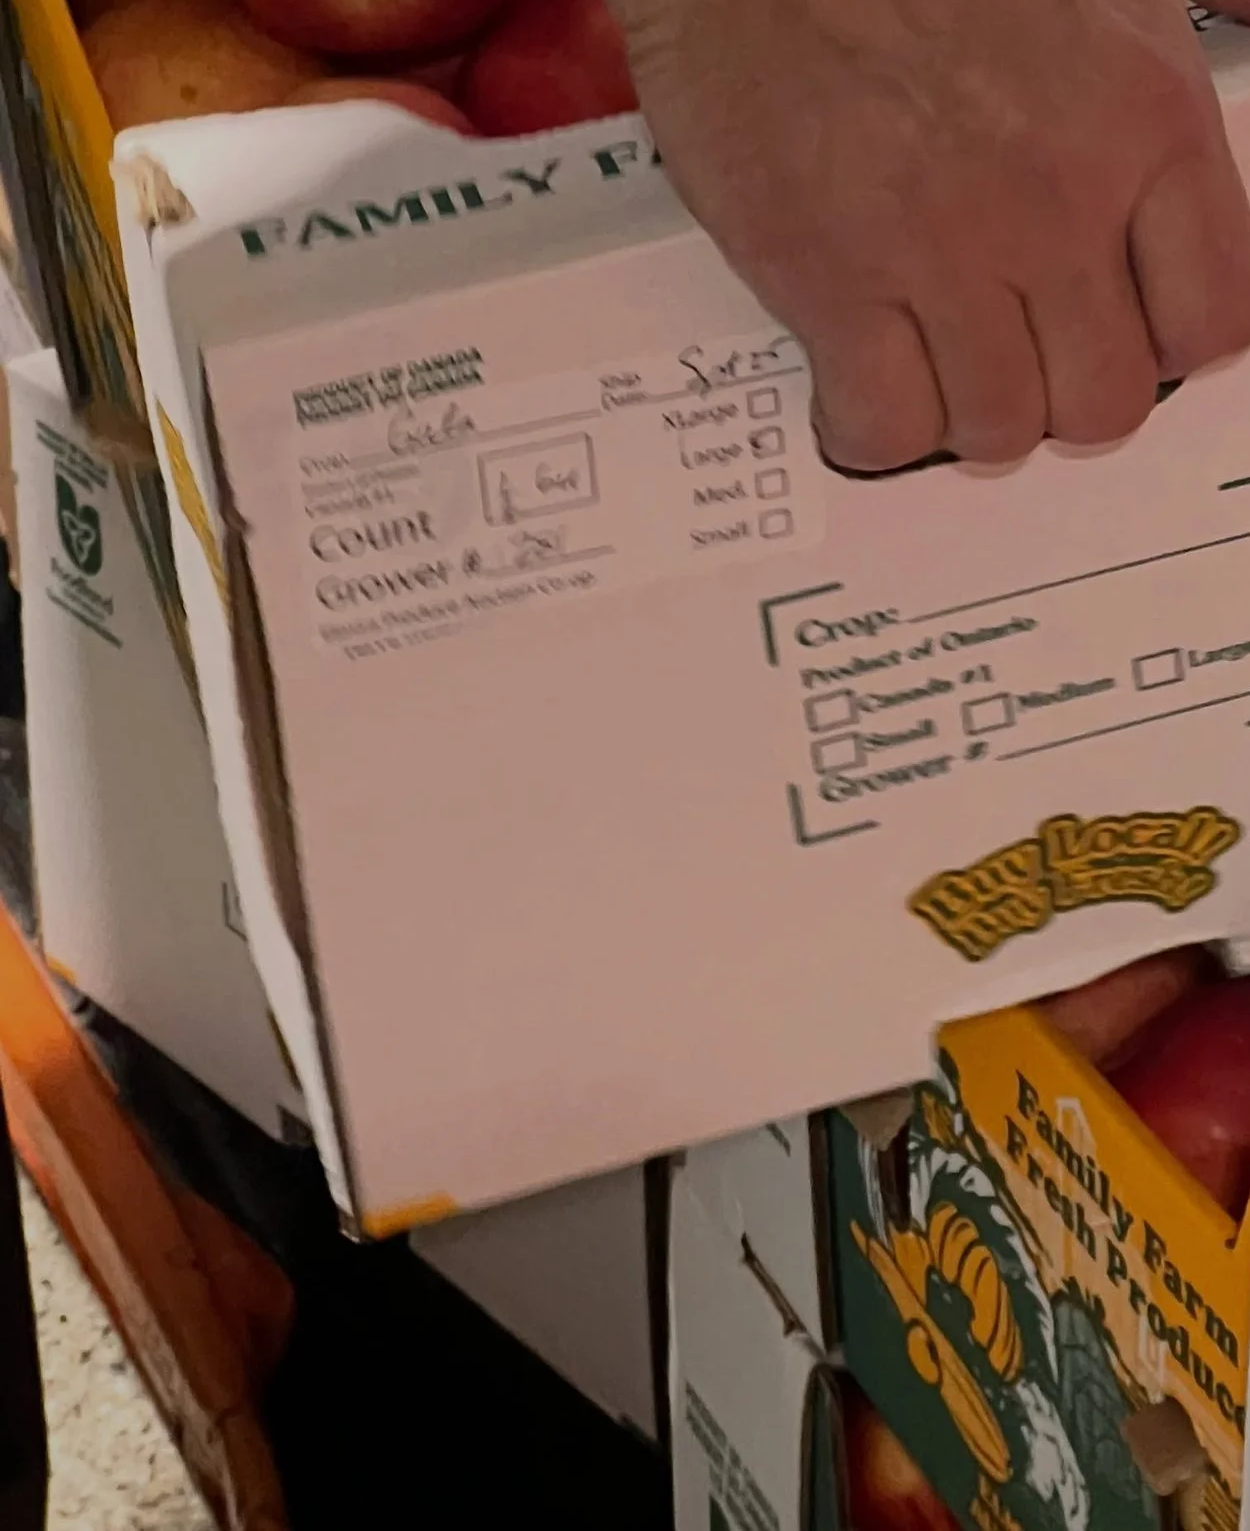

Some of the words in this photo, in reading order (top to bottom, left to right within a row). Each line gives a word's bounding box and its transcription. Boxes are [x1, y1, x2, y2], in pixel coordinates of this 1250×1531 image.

[239, 156, 562, 257] FAMILY
[307, 509, 438, 564] Count
[1004, 1114, 1097, 1263] Fresh
[1014, 1068, 1135, 1244] Family
[1142, 1219, 1240, 1369] Farm
